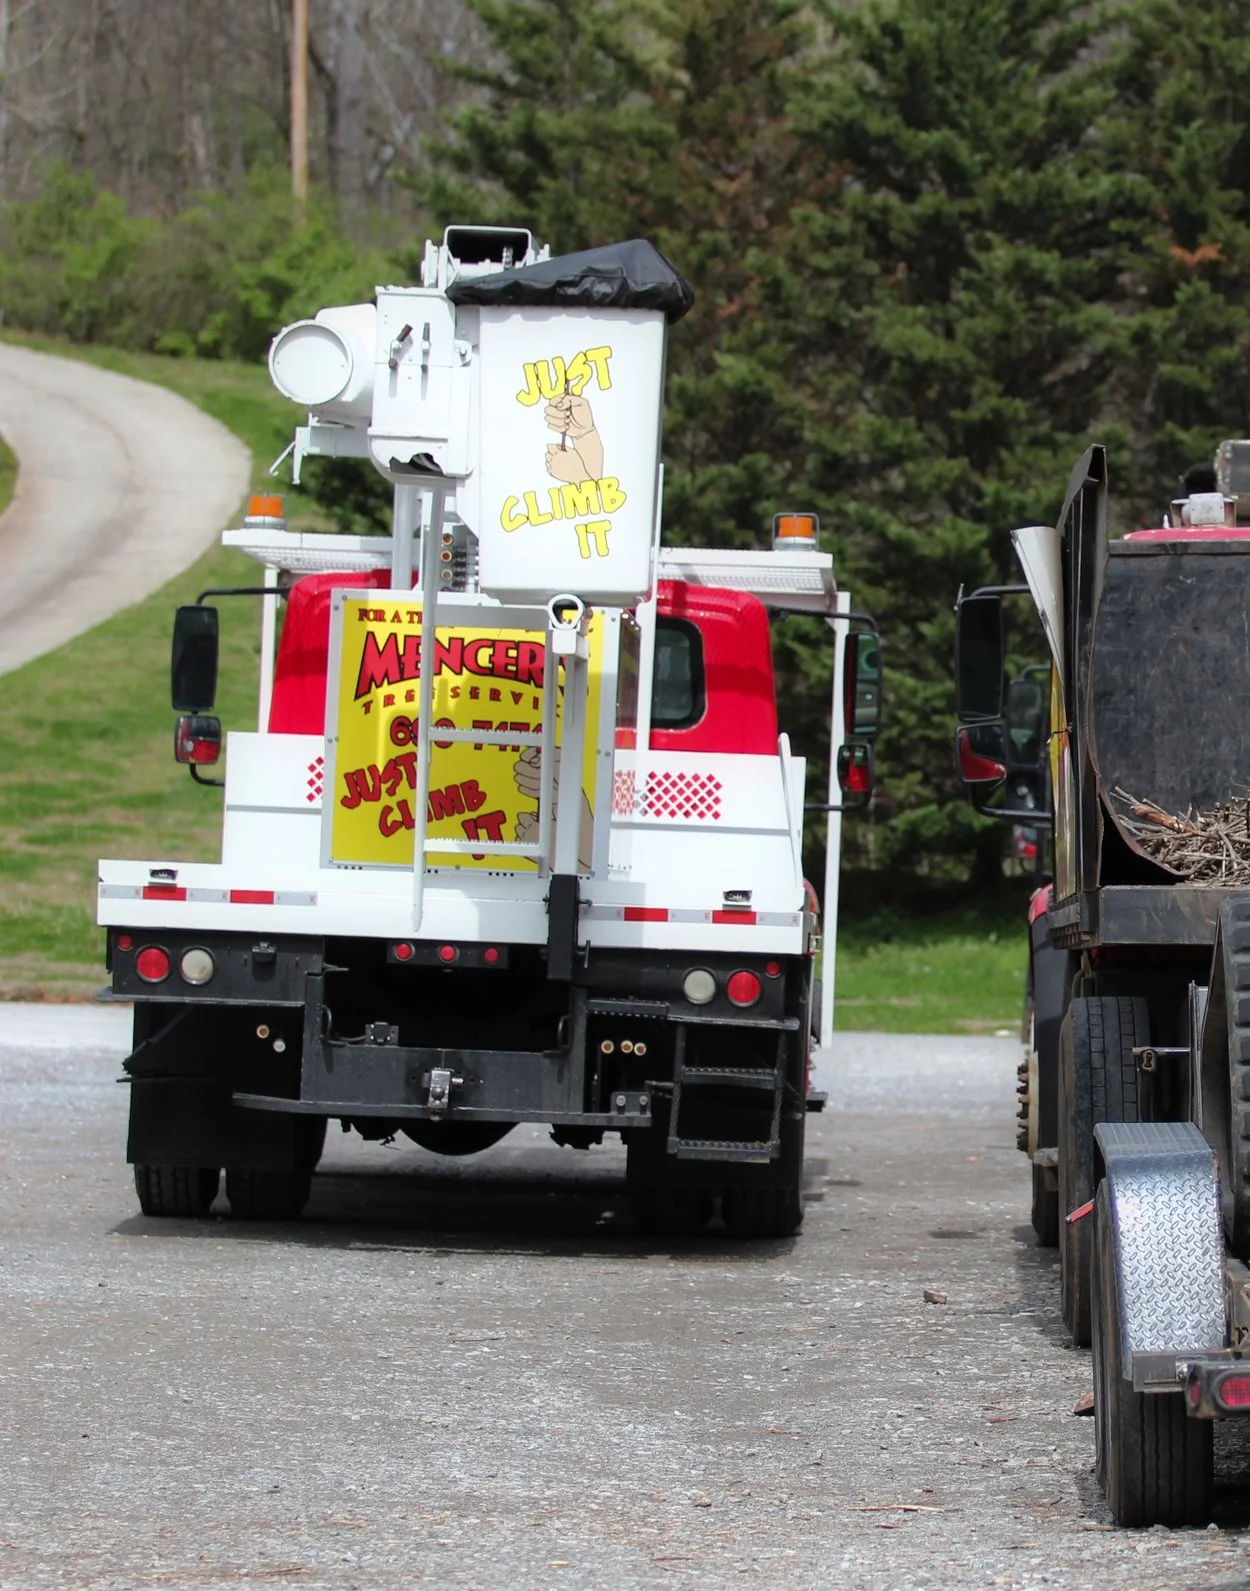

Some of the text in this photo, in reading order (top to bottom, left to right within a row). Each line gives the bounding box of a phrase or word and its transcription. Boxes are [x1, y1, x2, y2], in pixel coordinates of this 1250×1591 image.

[516, 346, 612, 407] JUST
[500, 477, 627, 532] CLIMB
[575, 520, 611, 559] IT
[358, 608, 386, 622] FOR
[390, 610, 402, 623] A
[354, 631, 589, 701] MENCER
[362, 686, 561, 717] TRE SERVI
[340, 751, 418, 810] JUST
[461, 810, 507, 860] IT
